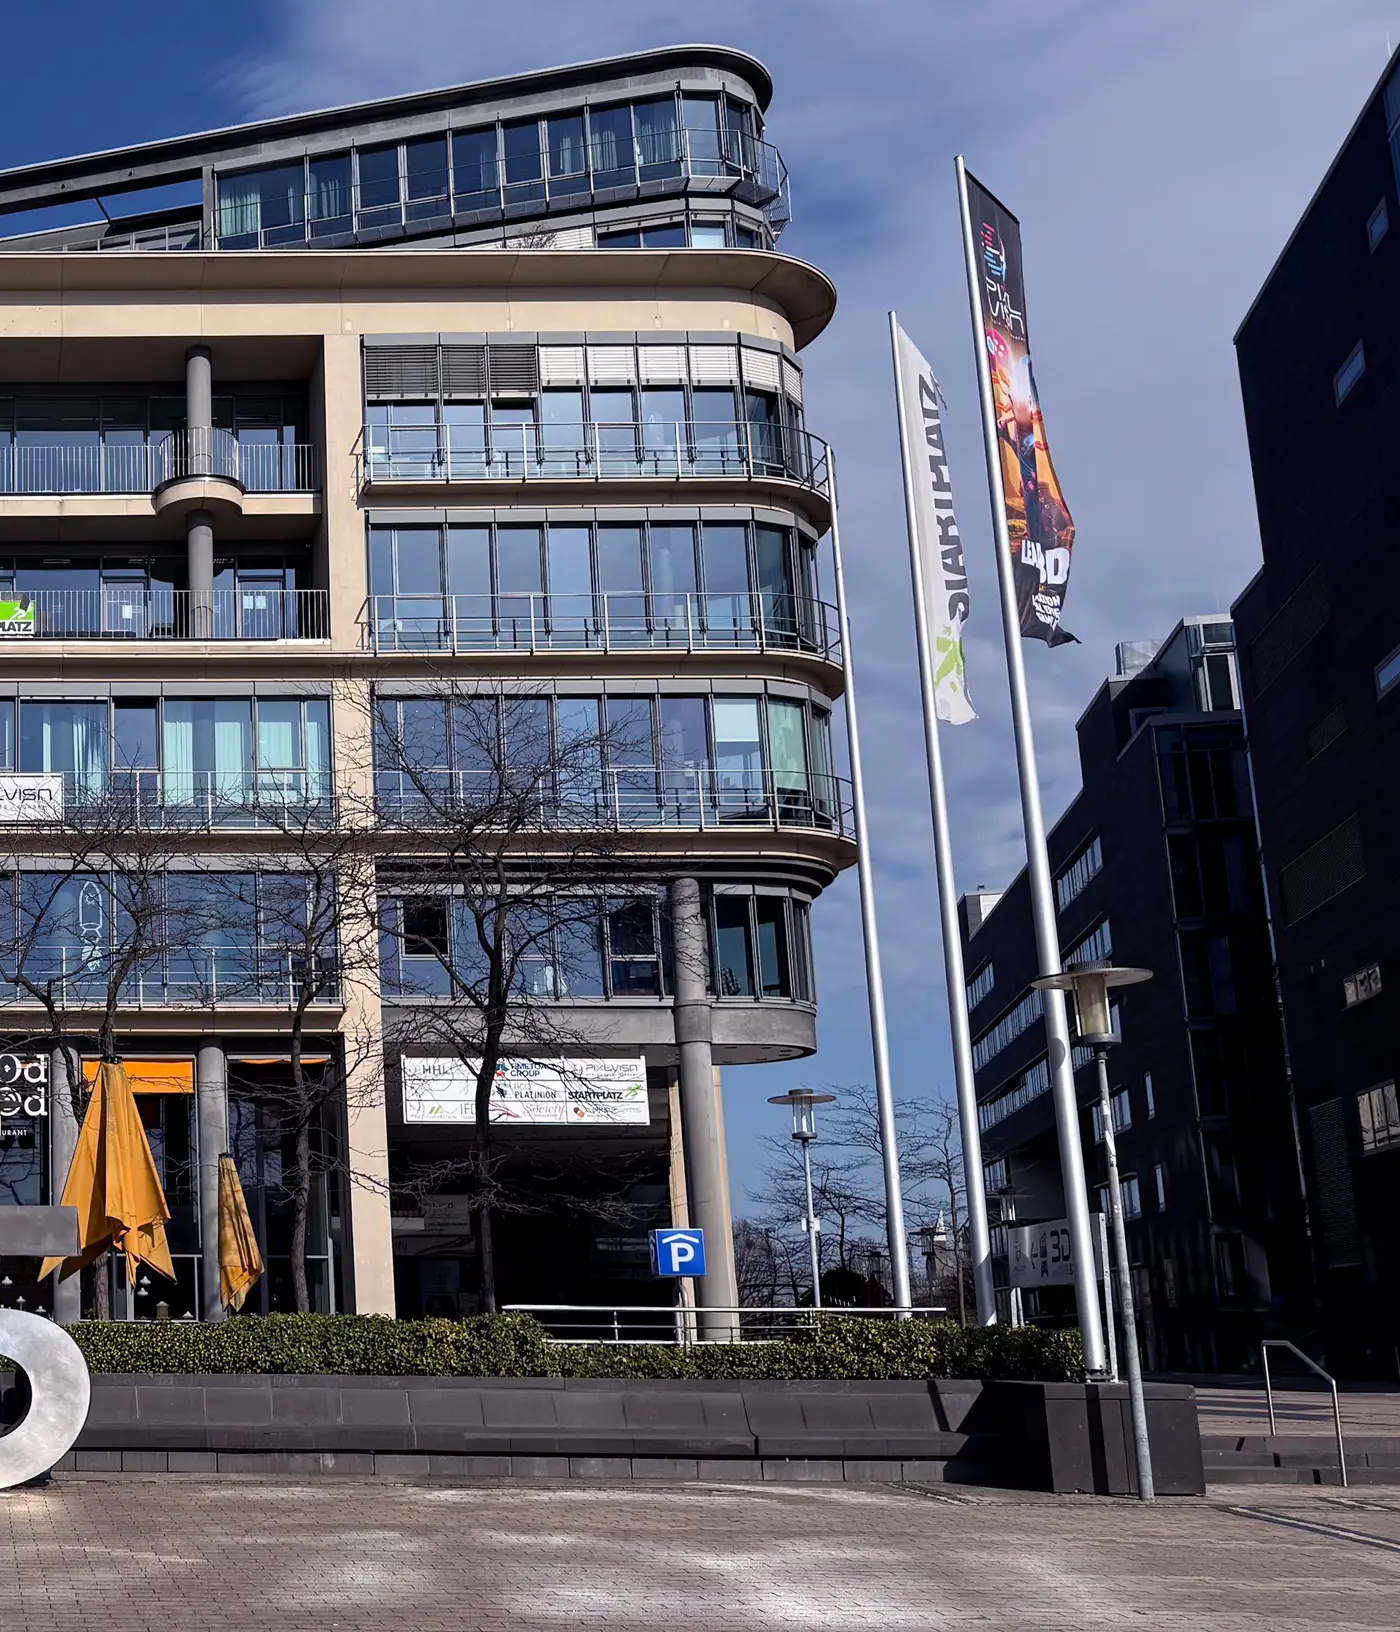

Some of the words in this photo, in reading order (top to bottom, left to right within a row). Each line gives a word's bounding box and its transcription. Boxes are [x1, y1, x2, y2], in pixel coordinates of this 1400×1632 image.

[510, 1069, 540, 1077] GROUP
[514, 1091, 557, 1099] PLATINION
[670, 1242, 695, 1272] P
